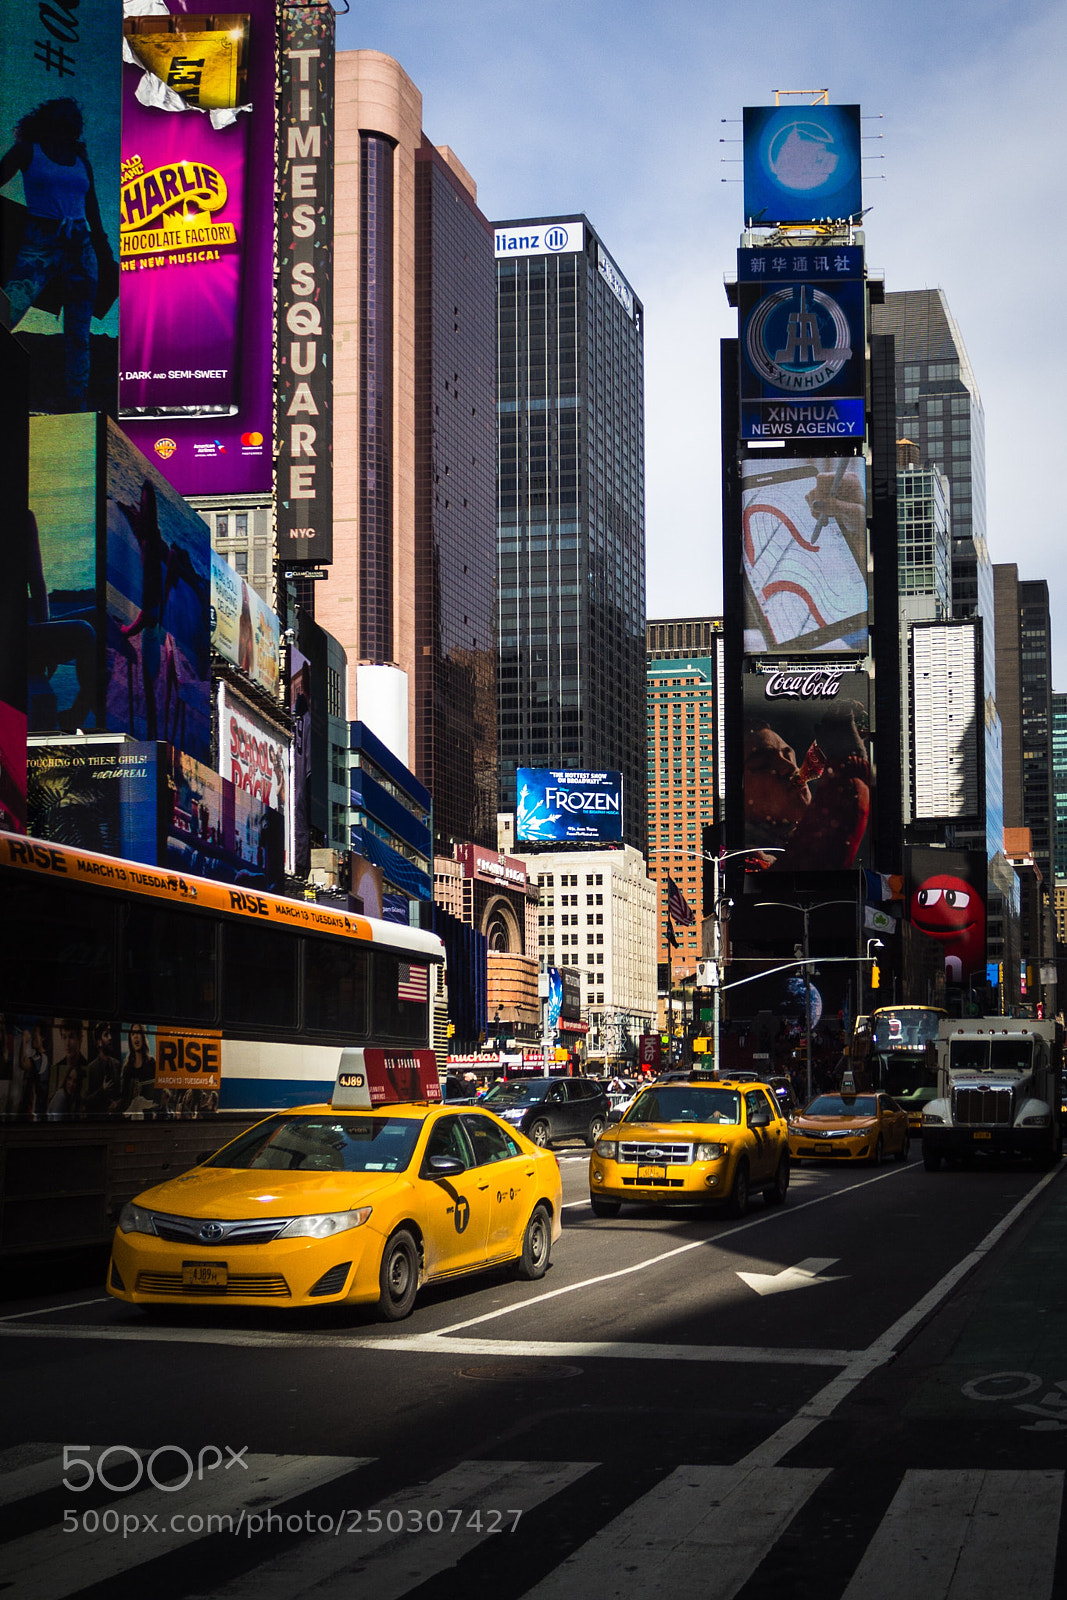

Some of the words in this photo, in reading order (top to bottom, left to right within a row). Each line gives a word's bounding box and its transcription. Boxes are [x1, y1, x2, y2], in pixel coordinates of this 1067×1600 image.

[287, 48, 321, 238] TIMES
[121, 166, 218, 224] HARLIE
[120, 231, 182, 251] HOCOLATE
[185, 226, 232, 244] FACTORY
[496, 234, 540, 251] lianz
[140, 256, 165, 270] NEW
[169, 250, 220, 264] MUSICAL
[750, 255, 851, 273] 新华通讯社
[125, 370, 152, 381] DARK
[153, 372, 167, 380] AND
[168, 369, 228, 380] SEMI-SWEET
[286, 262, 322, 499] SQUARE
[775, 367, 835, 388] XINHUA
[767, 406, 839, 422] XINHUA
[751, 423, 793, 435] NEWS
[796, 421, 856, 435] AGENCY
[289, 528, 316, 539] NYC
[765, 671, 844, 698] Coca-Cola
[230, 715, 272, 780] SCHOOL
[72, 757, 86, 767] ON
[88, 756, 117, 767] THESE
[118, 755, 148, 765] GIRLS!
[545, 787, 619, 814] FROZEN
[6, 838, 68, 873] RISE
[77, 859, 114, 877] MARCH
[115, 868, 127, 881] 13
[129, 871, 178, 892] TUESDAYS
[229, 890, 269, 916] RISE
[274, 904, 300, 918] MARCH
[300, 910, 309, 921] 13
[311, 912, 344, 928] TUESDAYS
[158, 1039, 218, 1073] RISE
[644, 1036, 656, 1062] tkts
[384, 1058, 395, 1069] RED
[397, 1058, 421, 1069] SPARROW
[157, 1076, 176, 1084] MARCH
[339, 1075, 363, 1087] 4J89
